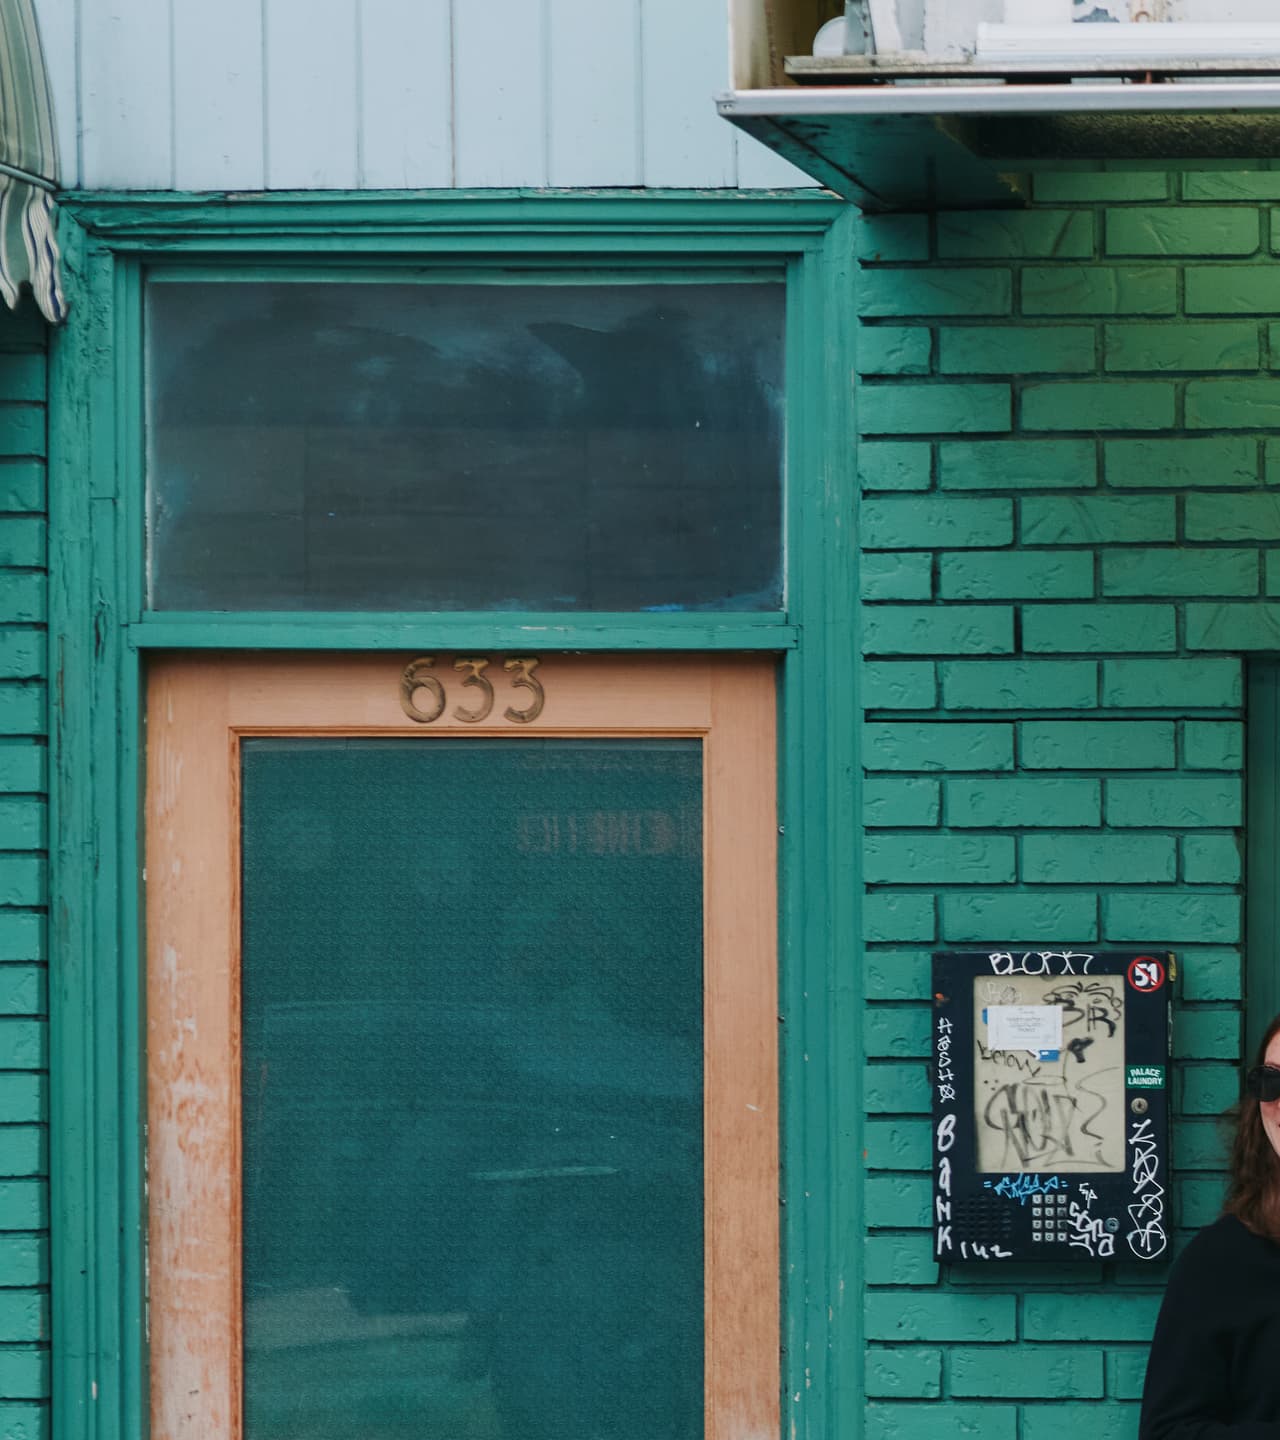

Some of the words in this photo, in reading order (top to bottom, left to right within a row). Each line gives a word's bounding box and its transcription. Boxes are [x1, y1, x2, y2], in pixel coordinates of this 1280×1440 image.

[400, 655, 545, 724] 633
[1129, 1067, 1161, 1078] PALACE
[1127, 1076, 1163, 1086] LAUNDRY
